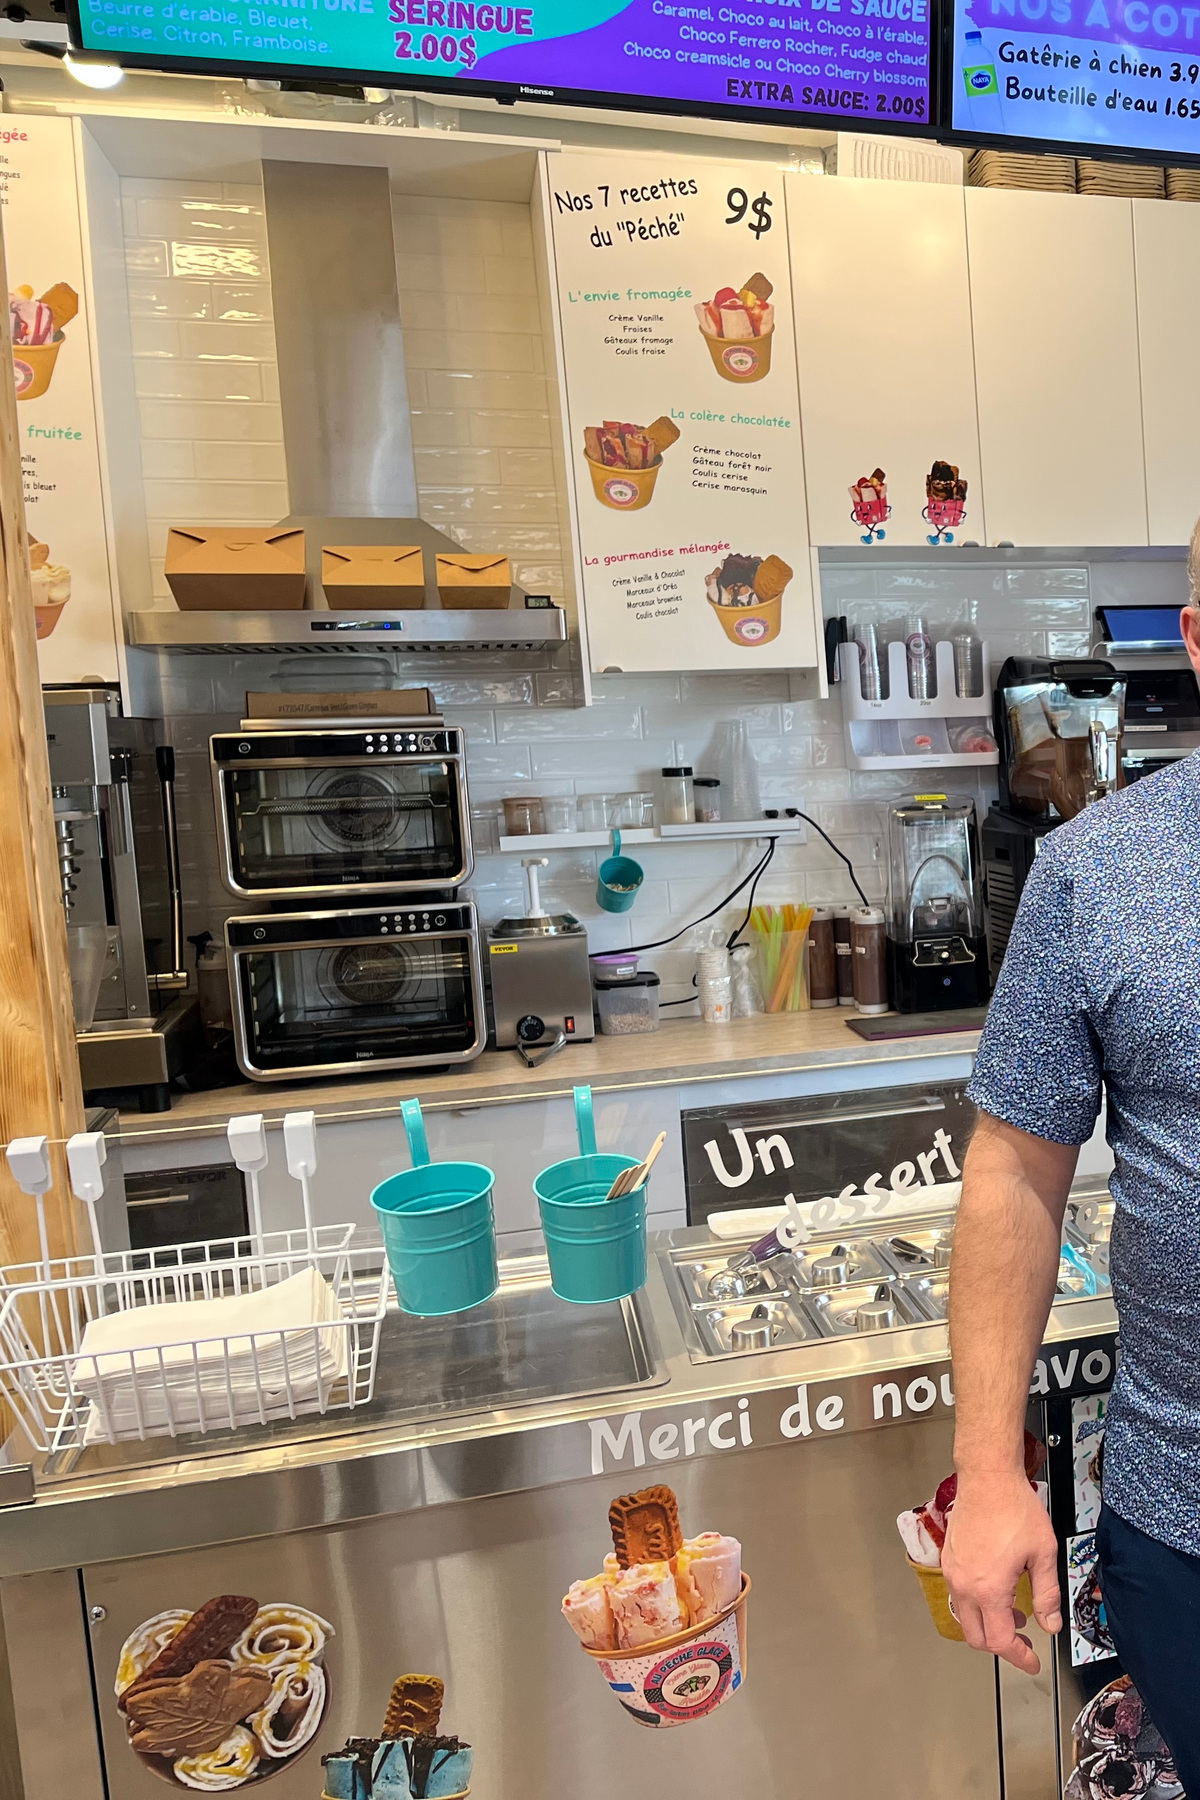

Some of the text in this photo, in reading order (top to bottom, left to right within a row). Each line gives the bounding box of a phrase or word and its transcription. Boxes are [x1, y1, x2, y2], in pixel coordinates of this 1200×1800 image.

[89, 0, 154, 18] Beurre
[161, 2, 243, 25] d'érable,
[250, 9, 314, 31] Bleuet,
[388, 0, 534, 36] SERINGUE
[652, 1, 861, 38] Caramel, Choco au lait, Choco
[91, 20, 333, 54] Cerise, Citron, Framboise.
[679, 25, 928, 67] Choco Ferrero Rocher, Fudge chaud
[395, 31, 477, 69] 2.00$
[623, 41, 928, 89] Choco creamsicle ou Choco Cherry blossom
[1108, 57, 1162, 80] chien
[520, 86, 554, 96] Hisense
[726, 78, 926, 118] EXTRA SAUCE: 2.00$
[1005, 76, 1098, 108] Bouteille
[1105, 88, 1158, 114] d'eau
[554, 178, 773, 240] Nos 7 recettes 9$
[590, 225, 613, 248] du
[568, 287, 693, 303] L'envie fromagée
[608, 314, 664, 323] Crème Vanille
[623, 325, 653, 334] Fraises
[615, 347, 666, 356] Coulis fraise
[641, 336, 674, 346] fromage
[671, 408, 791, 429] La colère chocolatée
[27, 424, 82, 441] fruitée
[693, 445, 762, 460] Crème chocolat
[692, 469, 749, 482] Coulis cerise
[755, 463, 772, 473] noir
[33, 482, 56, 491] bleuet
[692, 480, 768, 496] Cerise marasquin
[584, 540, 731, 567] La gourmandise mélangée
[633, 574, 653, 584] Vanille
[661, 569, 686, 580] Chocolat
[657, 594, 683, 606] brownies
[635, 607, 679, 621] Coulis chocolat
[703, 1128, 794, 1188] Un
[774, 1128, 962, 1249] dessert
[588, 1399, 753, 1475] Merci
[779, 1384, 845, 1439] de
[873, 1374, 956, 1420] nou
